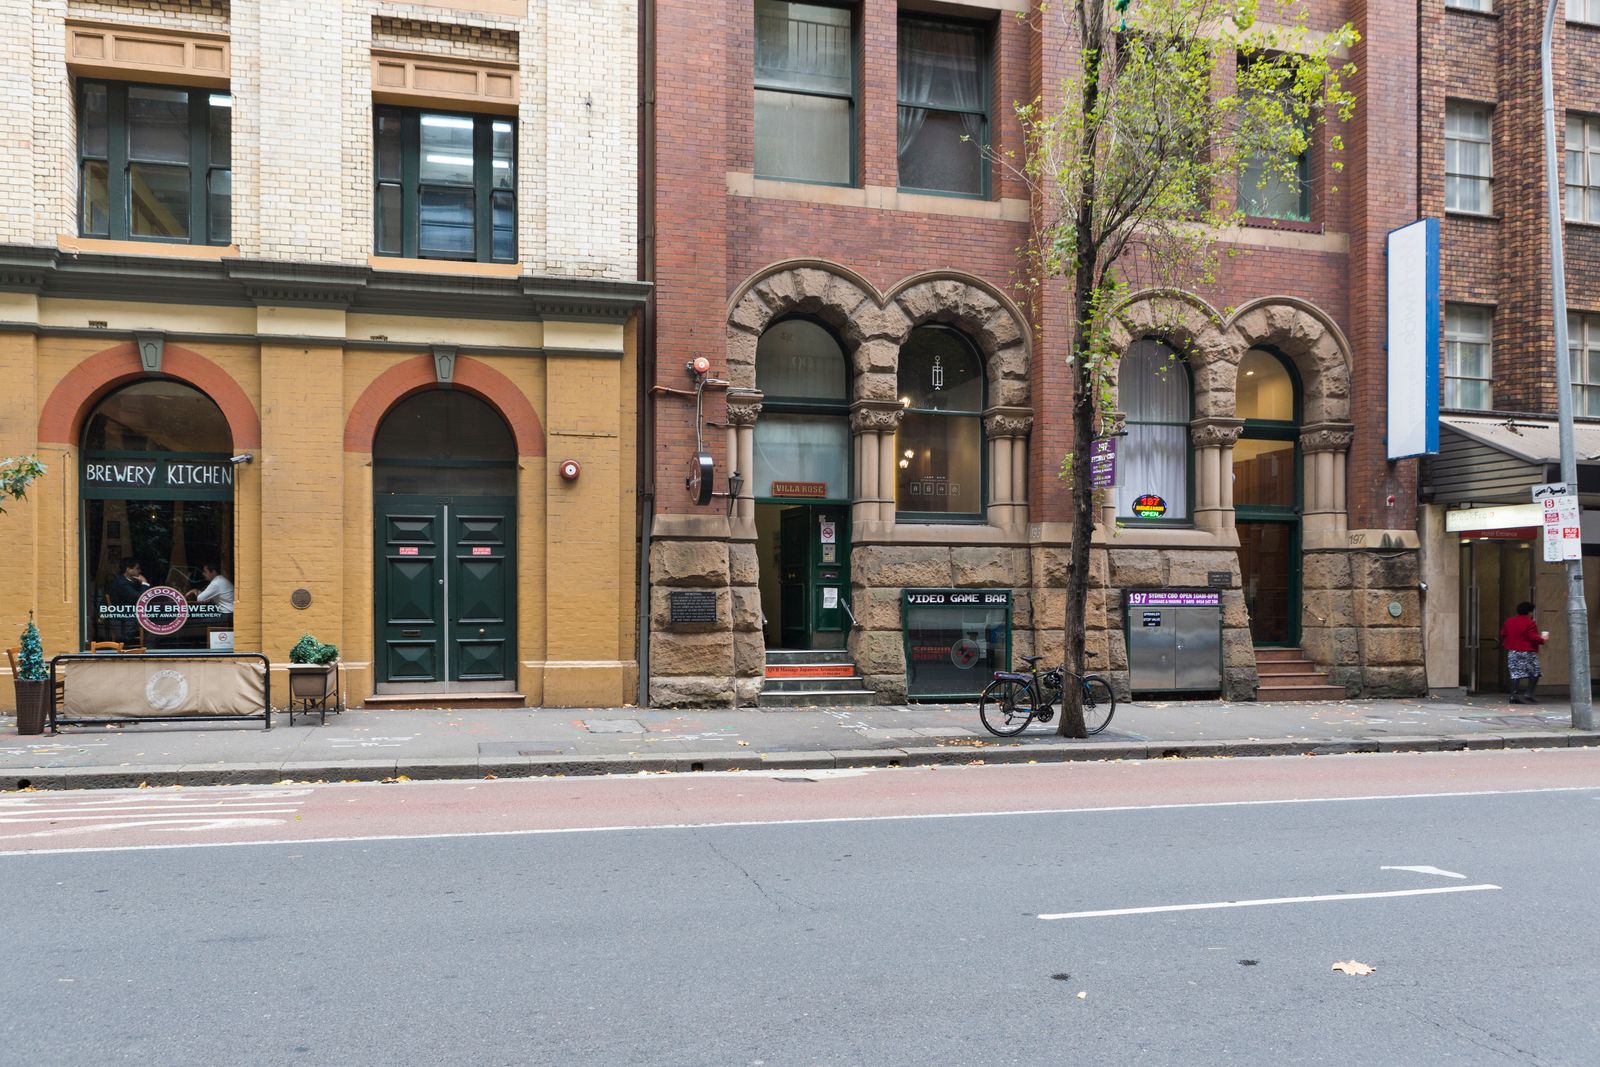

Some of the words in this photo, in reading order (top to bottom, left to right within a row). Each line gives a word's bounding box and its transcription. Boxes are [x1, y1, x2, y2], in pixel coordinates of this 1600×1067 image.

[86, 464, 156, 485] BREWERY
[167, 464, 232, 485] KITCHEN
[776, 484, 800, 493] VILLA
[801, 485, 824, 493] ROSE
[1141, 497, 1160, 506] 197
[1348, 533, 1366, 545] 197
[141, 588, 184, 603] REDOAK
[907, 594, 945, 603] VIDEO
[950, 594, 980, 603] GAME
[985, 594, 1007, 603] BAR
[1129, 593, 1147, 604] 197
[99, 605, 161, 613] BOUTIQUE
[164, 604, 221, 613] BREWERY
